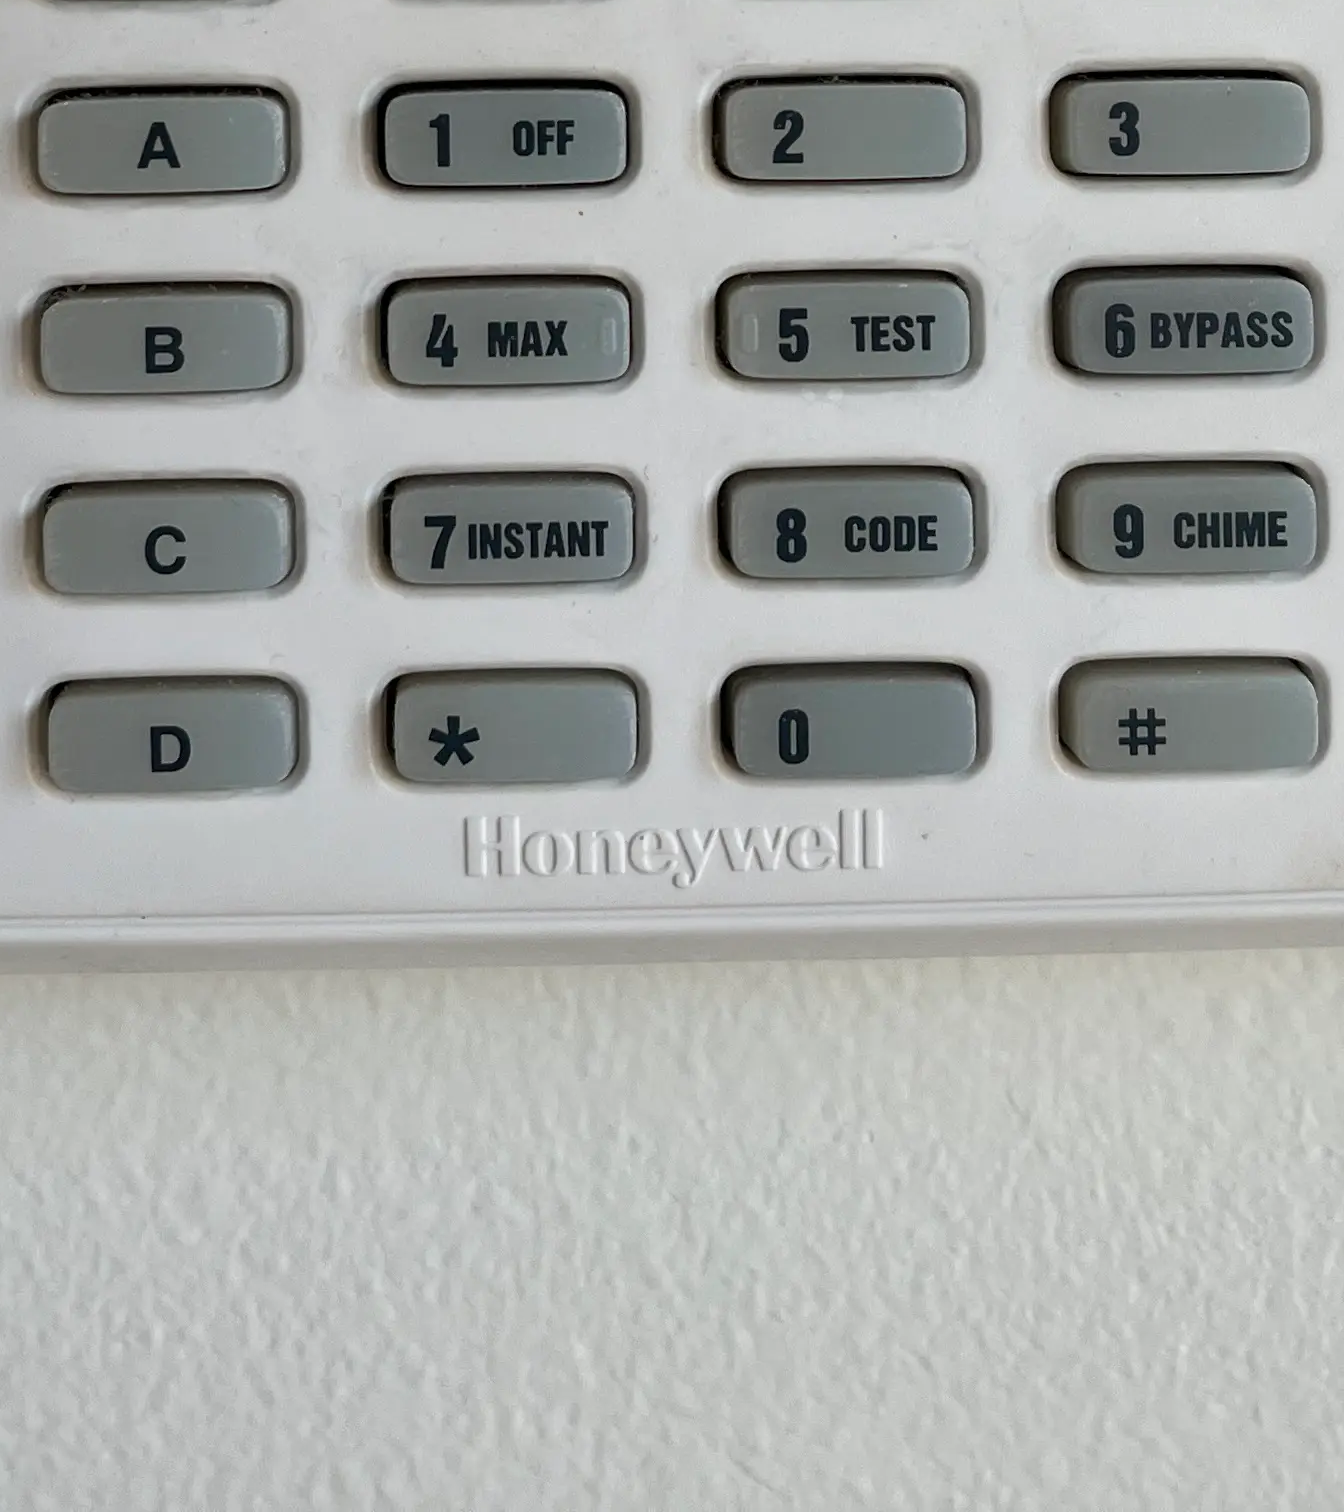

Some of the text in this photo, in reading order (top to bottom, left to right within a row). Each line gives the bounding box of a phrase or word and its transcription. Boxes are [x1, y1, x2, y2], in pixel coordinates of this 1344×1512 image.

[136, 121, 181, 170] A
[428, 113, 575, 168] 1 OFF
[772, 109, 804, 164] 2
[1108, 101, 1140, 157] 3
[144, 326, 185, 375] B
[425, 313, 568, 368] 4 MAX
[778, 307, 936, 363] 5 TEST
[1104, 303, 1294, 359] 6 BYPASS
[144, 525, 186, 575] C
[423, 515, 609, 570] 7 INSTANT
[775, 507, 938, 564] 8 CODE
[1113, 503, 1288, 559] 9 CHIME
[149, 725, 191, 773] D
[778, 708, 810, 765] 0
[462, 807, 885, 888] Honeywell
